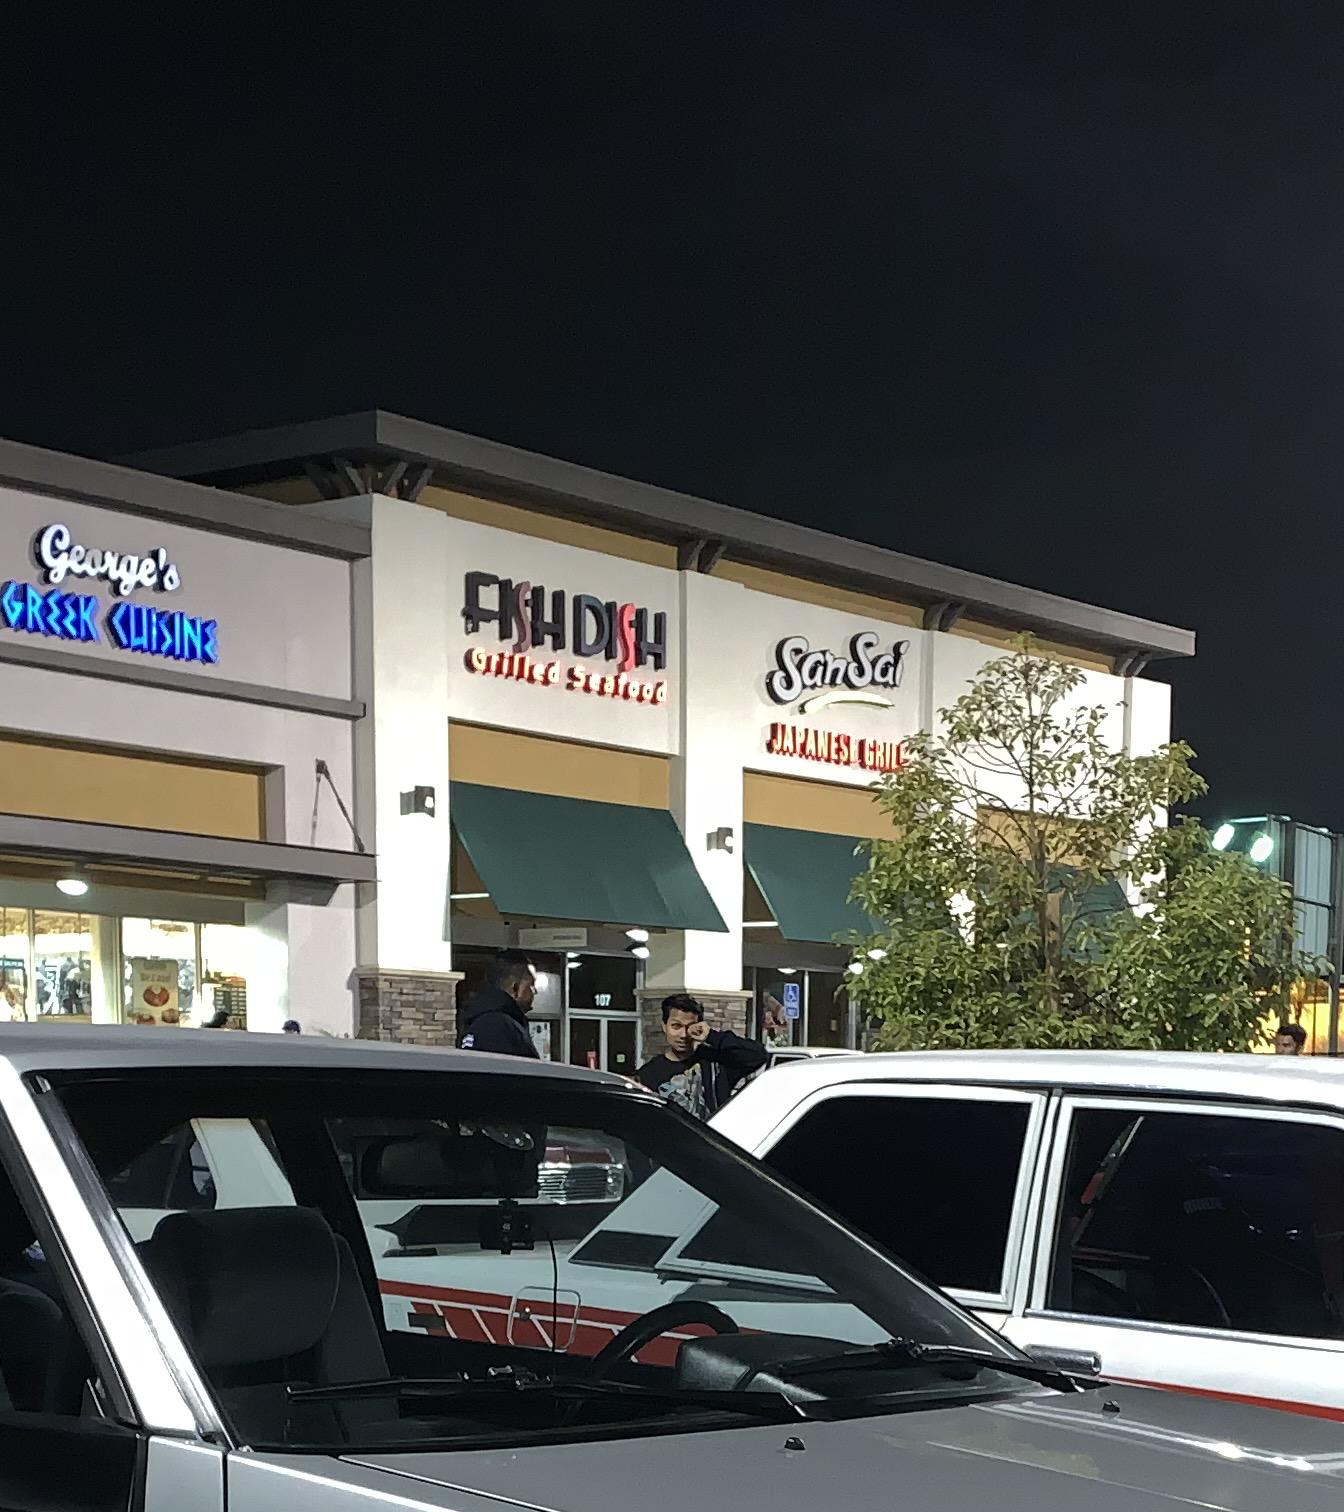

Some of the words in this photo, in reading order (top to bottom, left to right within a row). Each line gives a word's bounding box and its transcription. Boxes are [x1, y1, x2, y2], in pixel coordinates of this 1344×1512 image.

[36, 524, 180, 595] George's
[1, 581, 98, 641] GREEK
[109, 602, 218, 663] CUISINE
[462, 571, 565, 652] FISH
[573, 594, 667, 672] DISH
[465, 647, 560, 685] Grilled
[567, 665, 667, 704] Seafood
[767, 723, 858, 767] JAPANESE
[594, 993, 612, 1007] 107
